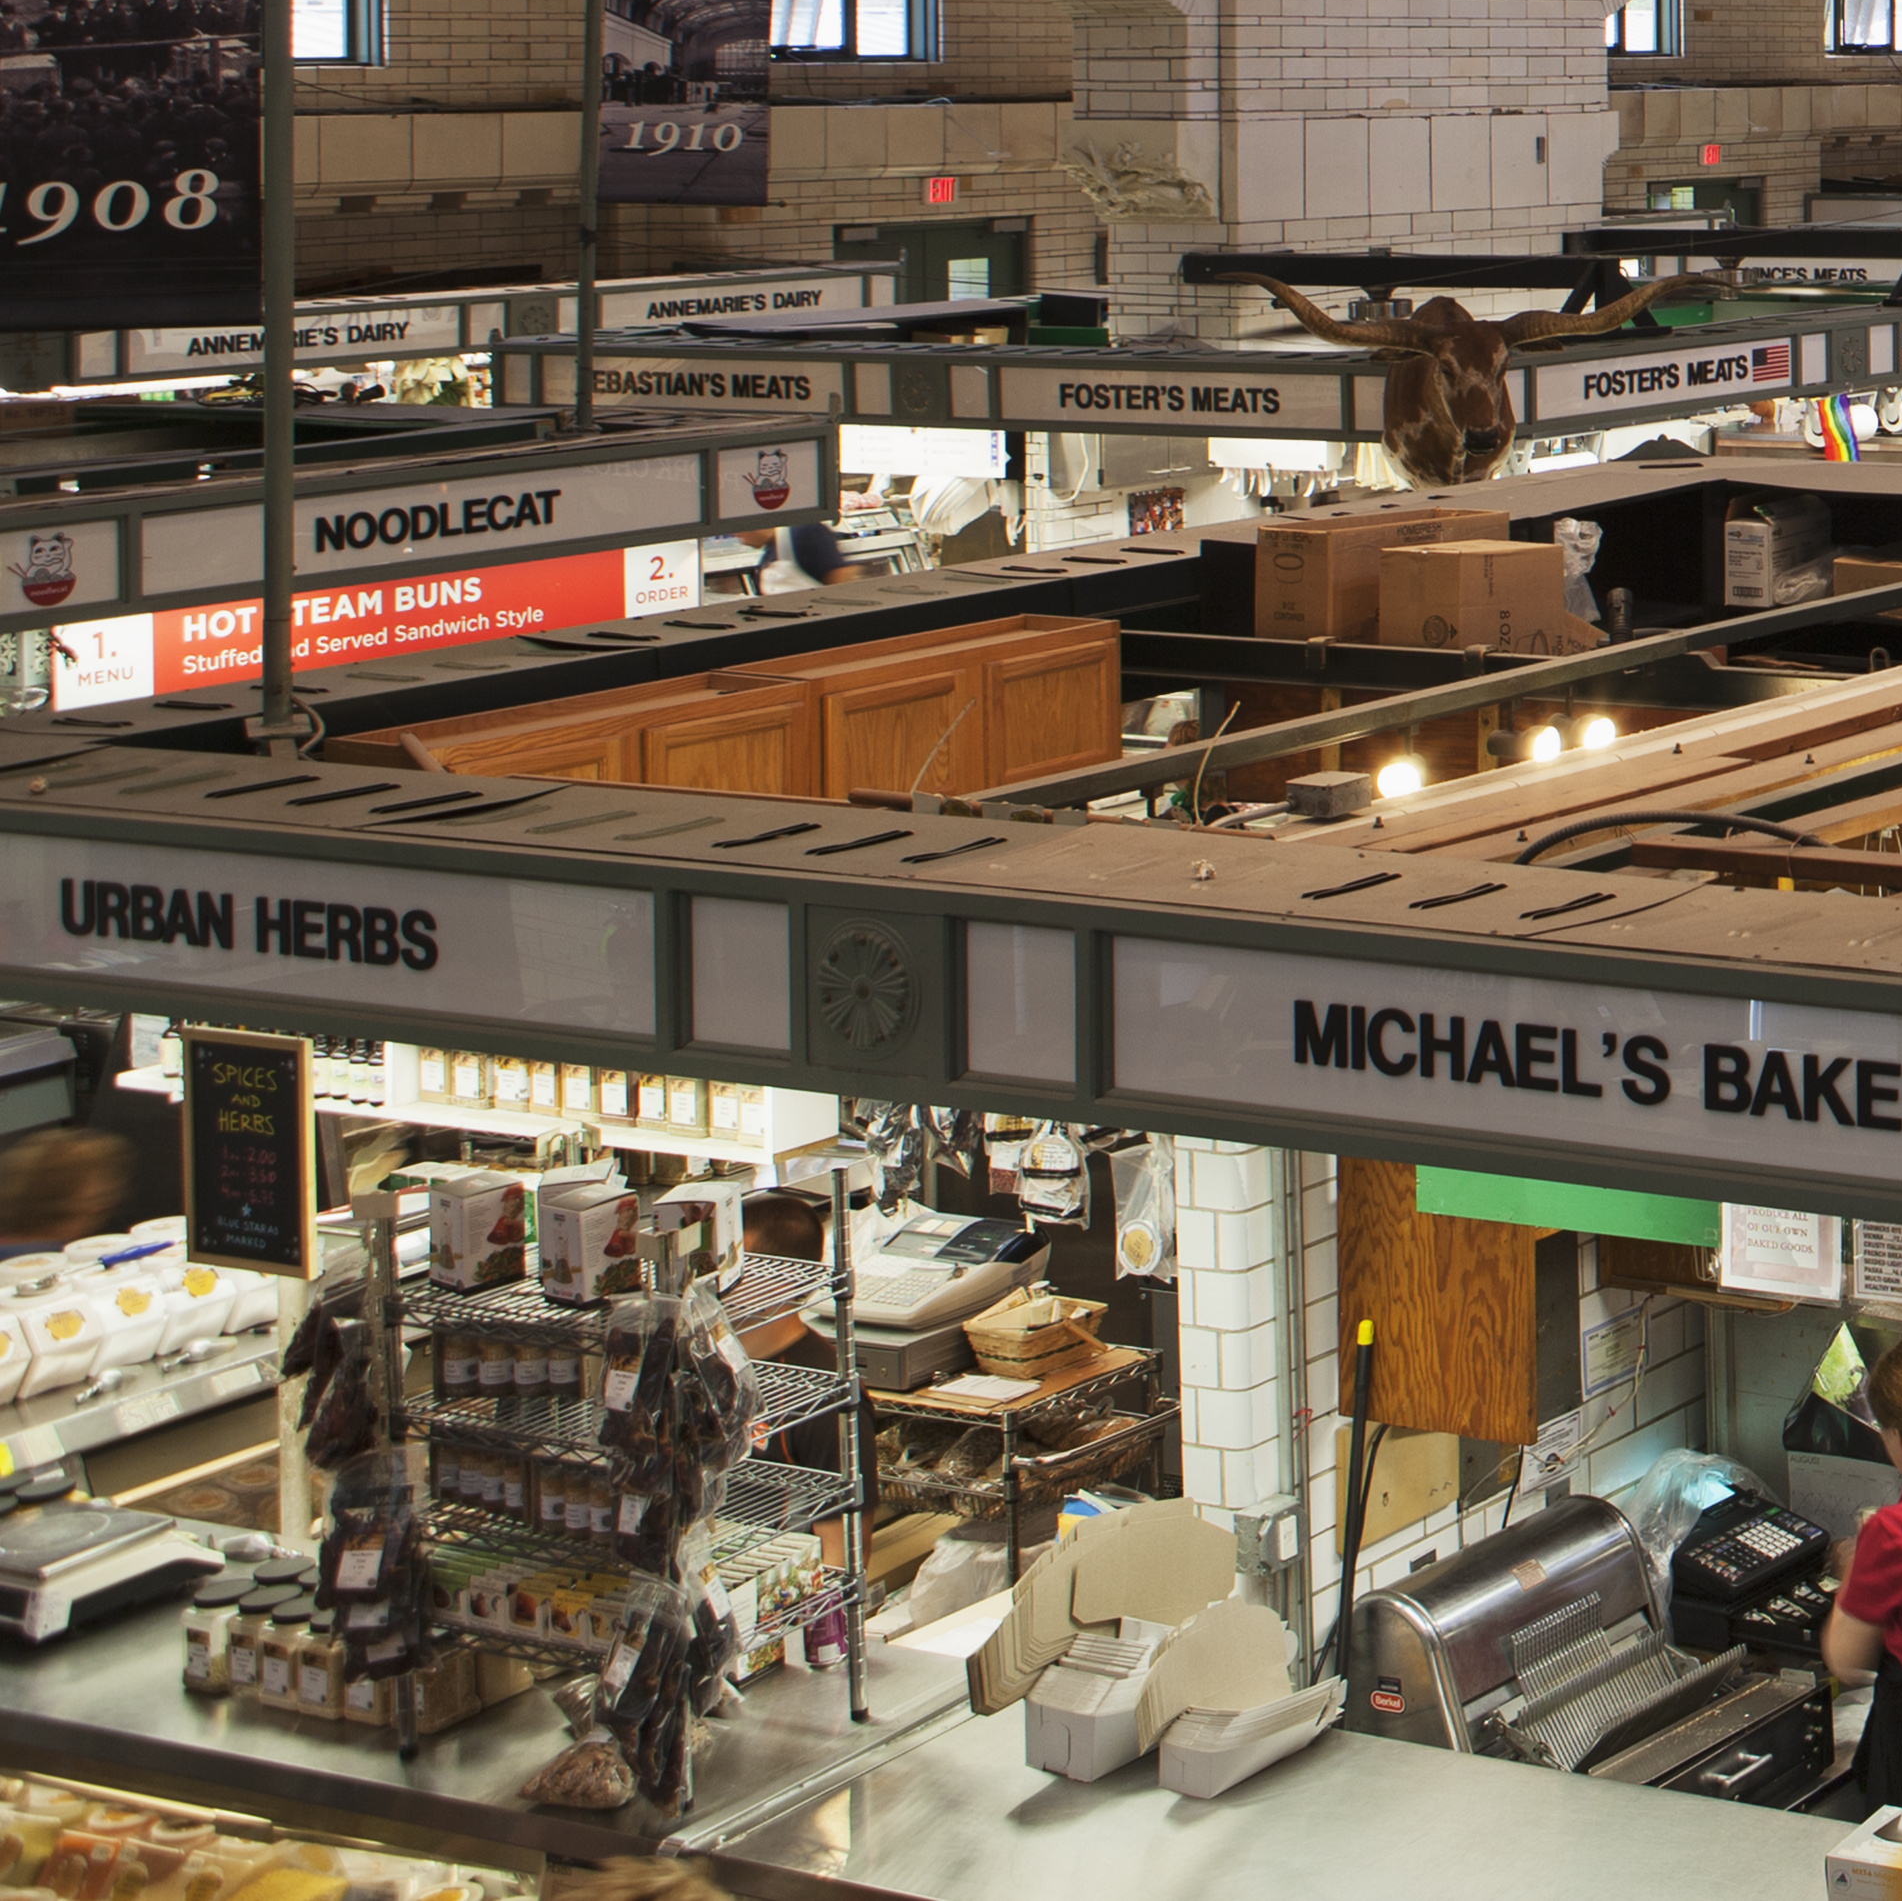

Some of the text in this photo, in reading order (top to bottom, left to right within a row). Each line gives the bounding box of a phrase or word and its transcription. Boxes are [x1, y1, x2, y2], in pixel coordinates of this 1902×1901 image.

[623, 120, 743, 156] 1910
[928, 177, 955, 203] EXIT
[0, 169, 219, 246] 908
[646, 289, 823, 319] ANNEMARIE'S DAIRY
[187, 321, 410, 356] ANNEMRIE'S DAIRY
[592, 369, 812, 400] EBASTIAN'S MEATS
[1583, 354, 1749, 399] FOSTER'S MEATS
[1058, 382, 1281, 415] FOSTER'S MEATS
[314, 489, 562, 553] NOODLECAT
[648, 554, 674, 582] 2.
[635, 583, 689, 605] ORDER
[185, 606, 258, 642] HOT
[292, 585, 383, 626] TEAM
[394, 576, 482, 612] BUNS
[92, 630, 117, 659] 1.
[183, 645, 263, 674] Stuffed
[315, 630, 388, 658] Served
[394, 618, 490, 649] Sandwich
[495, 606, 544, 632] Style
[78, 666, 134, 688] MENU
[60, 875, 439, 972] URBAN HERBS
[1293, 998, 1672, 1107] MICHAEL'S
[213, 1061, 278, 1091] SPICES
[230, 1093, 261, 1108] AND
[218, 1109, 275, 1136] HERBS
[217, 1215, 240, 1229] BLUE
[1747, 1206, 1809, 1222] PRODUCE ALL
[1747, 1221, 1808, 1238] OF OUR OWN
[1863, 1223, 1890, 1233] FARMERS
[1863, 1232, 1884, 1240] VIENNA
[226, 1233, 267, 1250] MARKED
[1747, 1237, 1815, 1255] BAKED GOODS.
[1863, 1240, 1886, 1249] CRUSTY
[1863, 1249, 1886, 1257] FRENCH
[1863, 1258, 1886, 1266] SEEDED
[1864, 1283, 1889, 1291] HEALTHY
[1883, 1276, 1901, 1284] GRAIN
[1790, 1453, 1822, 1466] AUGUST
[1374, 1693, 1402, 1707] Berkel
